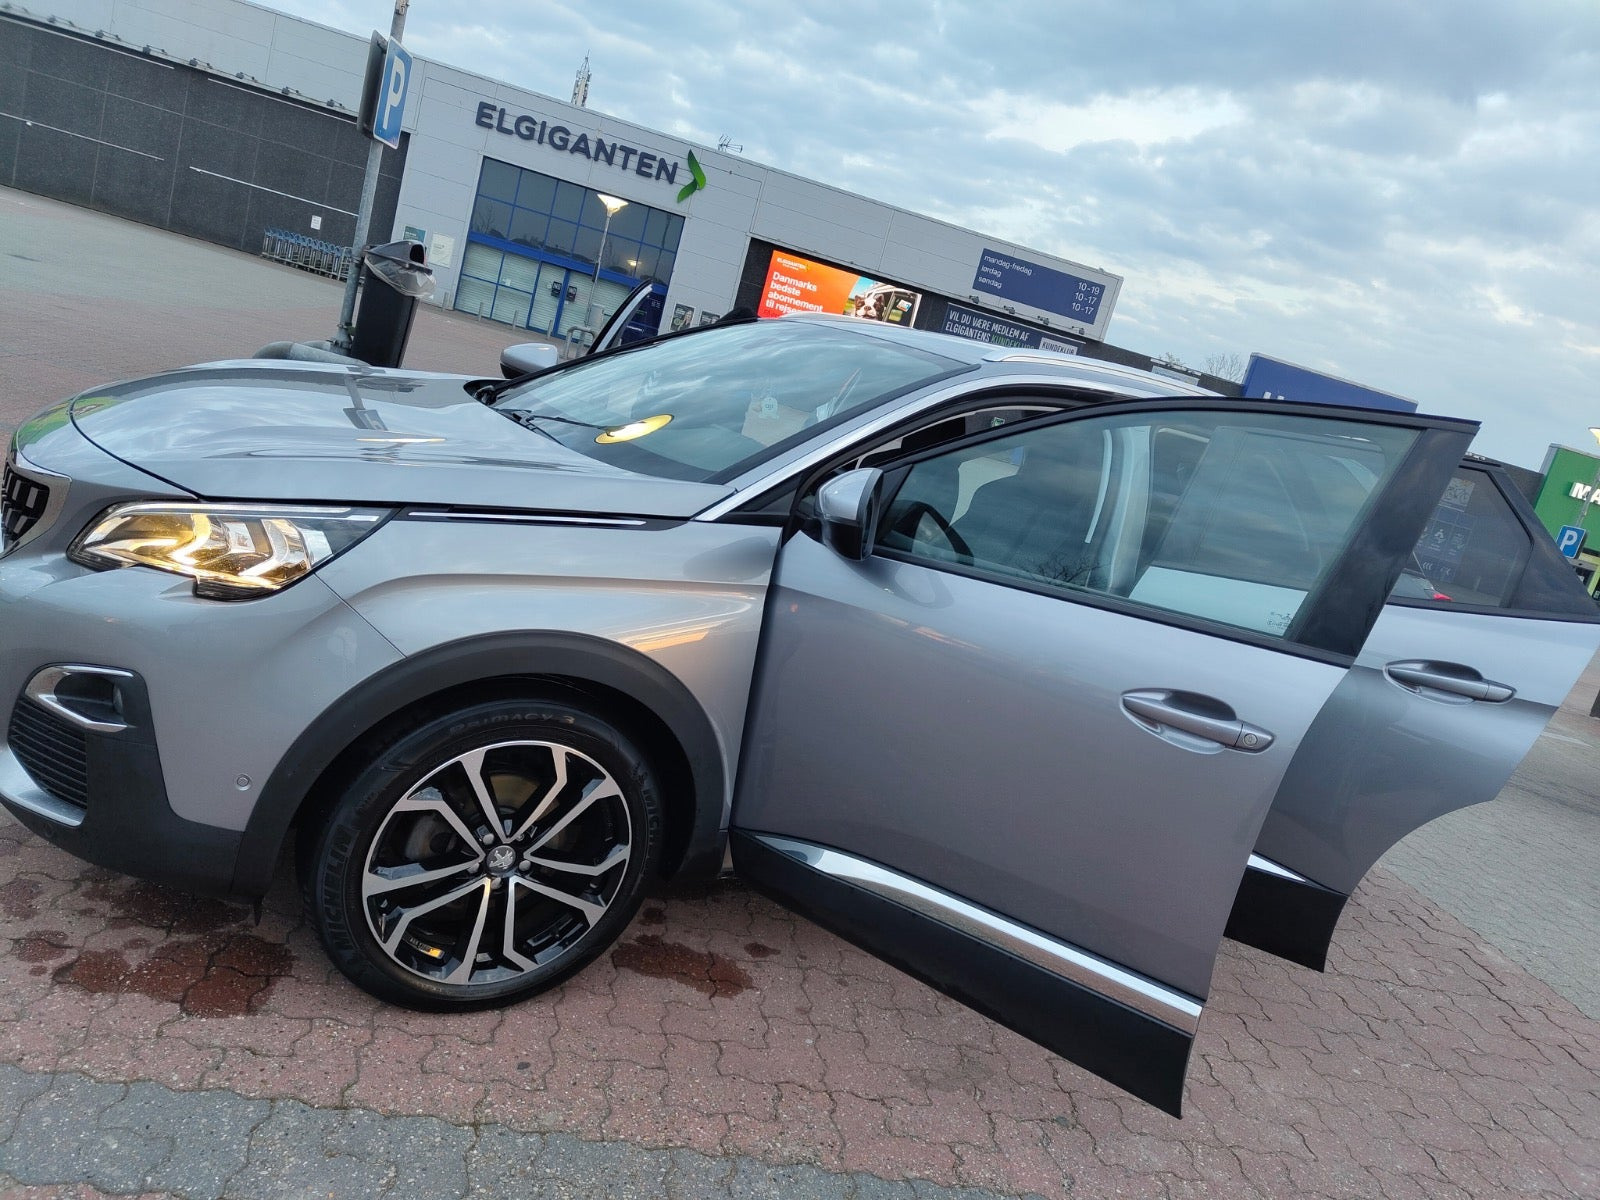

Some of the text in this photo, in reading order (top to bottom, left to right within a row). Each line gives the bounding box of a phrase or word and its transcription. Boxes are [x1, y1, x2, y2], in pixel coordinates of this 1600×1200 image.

[383, 57, 405, 129] P
[475, 101, 678, 184] ELGIGANTEN
[981, 265, 1002, 278] lørdag
[984, 255, 1032, 276] mandag-fredag
[770, 281, 801, 297] bedste
[772, 271, 817, 291] Danmarks
[978, 276, 1002, 289] søndag
[765, 299, 775, 309] til
[776, 302, 801, 314] rejse
[767, 291, 824, 312] abonnement
[945, 321, 991, 343] ELGIGANTENS
[949, 310, 1030, 341] VIL DU VÆRE MEDLEM AF
[1560, 530, 1578, 552] P
